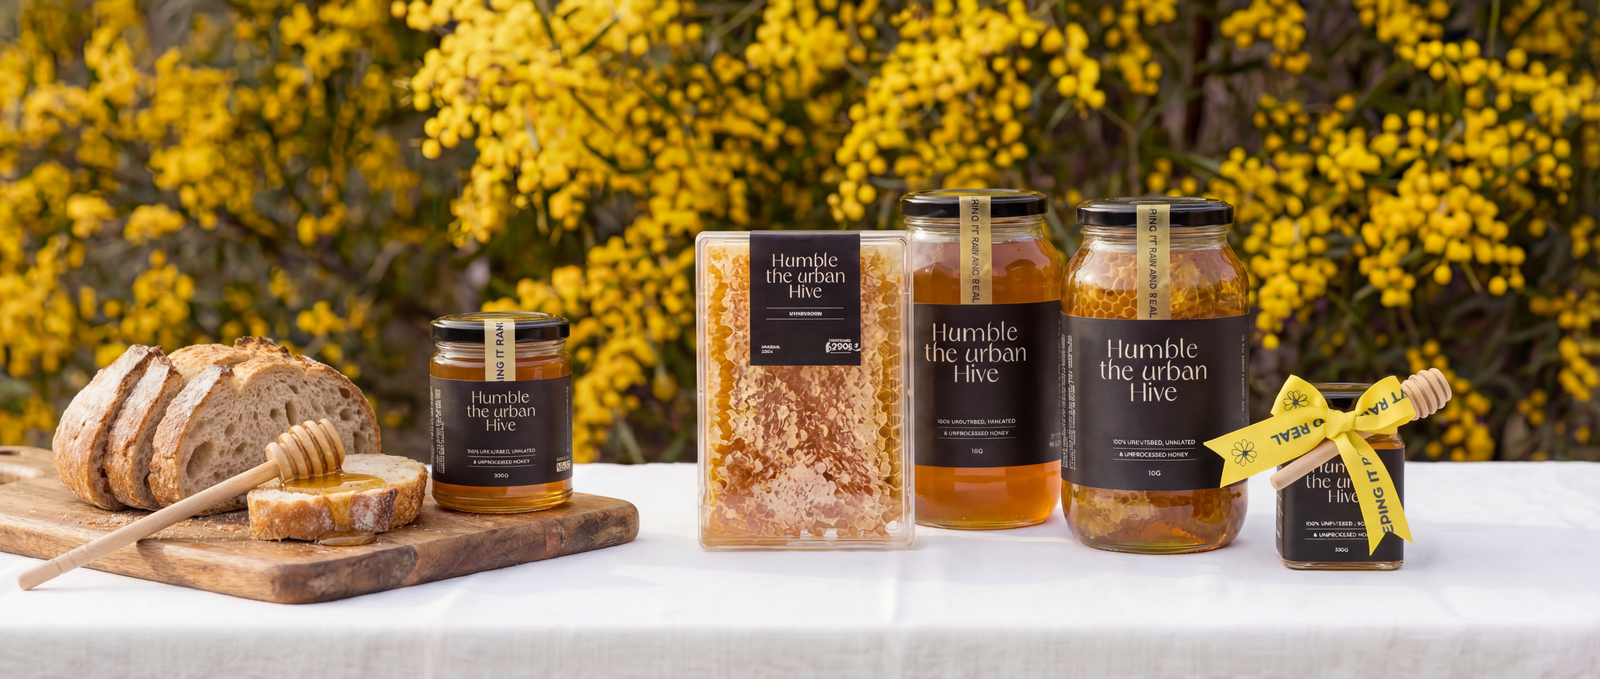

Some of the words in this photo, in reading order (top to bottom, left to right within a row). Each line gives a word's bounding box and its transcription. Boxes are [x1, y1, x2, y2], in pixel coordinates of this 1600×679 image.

[772, 252, 838, 268] Humble
[766, 267, 793, 284] the
[797, 266, 846, 284] urban
[789, 284, 823, 299] Hive
[932, 320, 1018, 342] Humble
[496, 349, 504, 358] IT
[924, 341, 958, 363] the
[965, 342, 1027, 363] urban
[1107, 337, 1198, 359] Humble
[954, 364, 999, 383] Hive
[1099, 358, 1134, 381] the
[1142, 360, 1207, 381] urban
[471, 390, 530, 405] Humble
[1130, 382, 1178, 402] Hive
[467, 404, 490, 418] the
[493, 404, 536, 418] urban
[486, 418, 517, 432] Hive
[1270, 422, 1311, 446] REAL
[1306, 474, 1331, 489] the
[1366, 470, 1380, 483] IT
